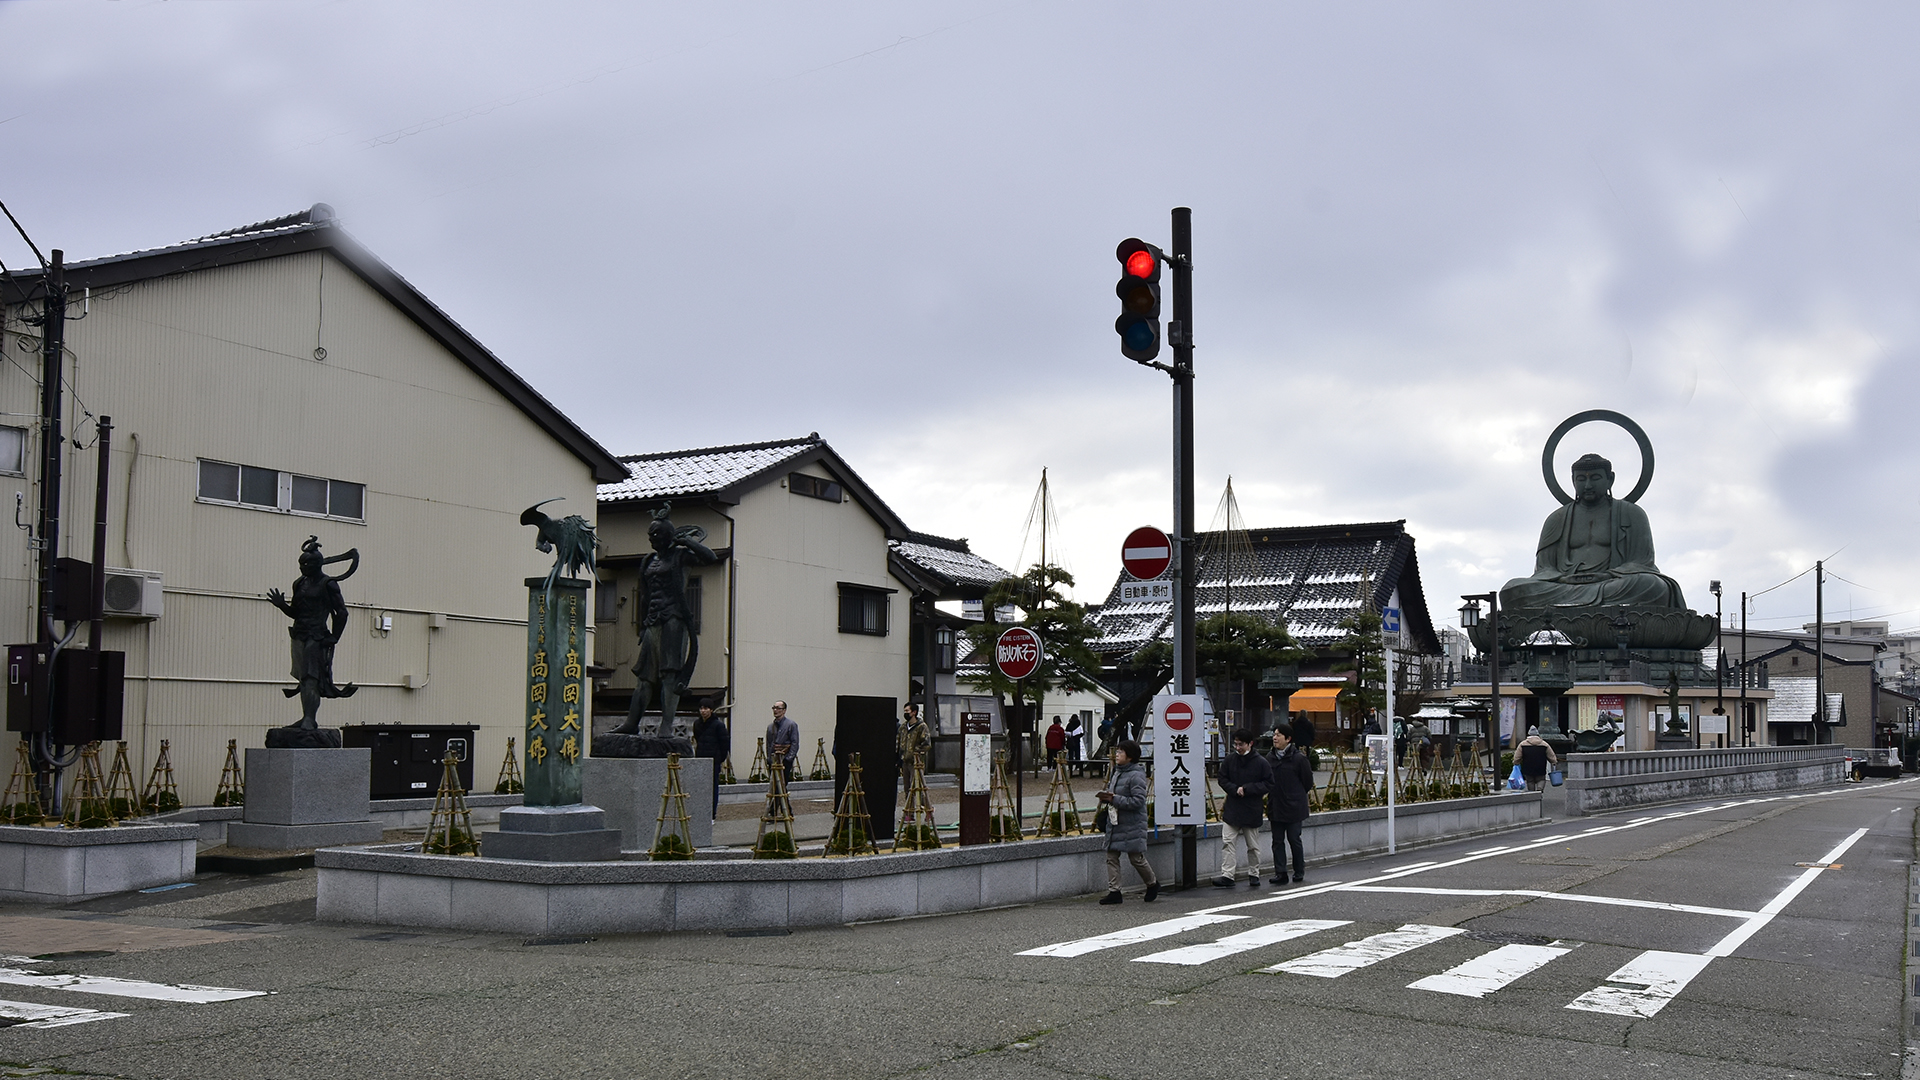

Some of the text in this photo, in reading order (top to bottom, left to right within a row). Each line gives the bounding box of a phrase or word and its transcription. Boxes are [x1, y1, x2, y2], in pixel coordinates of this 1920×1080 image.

[1124, 585, 1168, 599] 自動車・原付
[998, 643, 1036, 663] 防火水そう
[1170, 734, 1191, 817] 進入禁止
